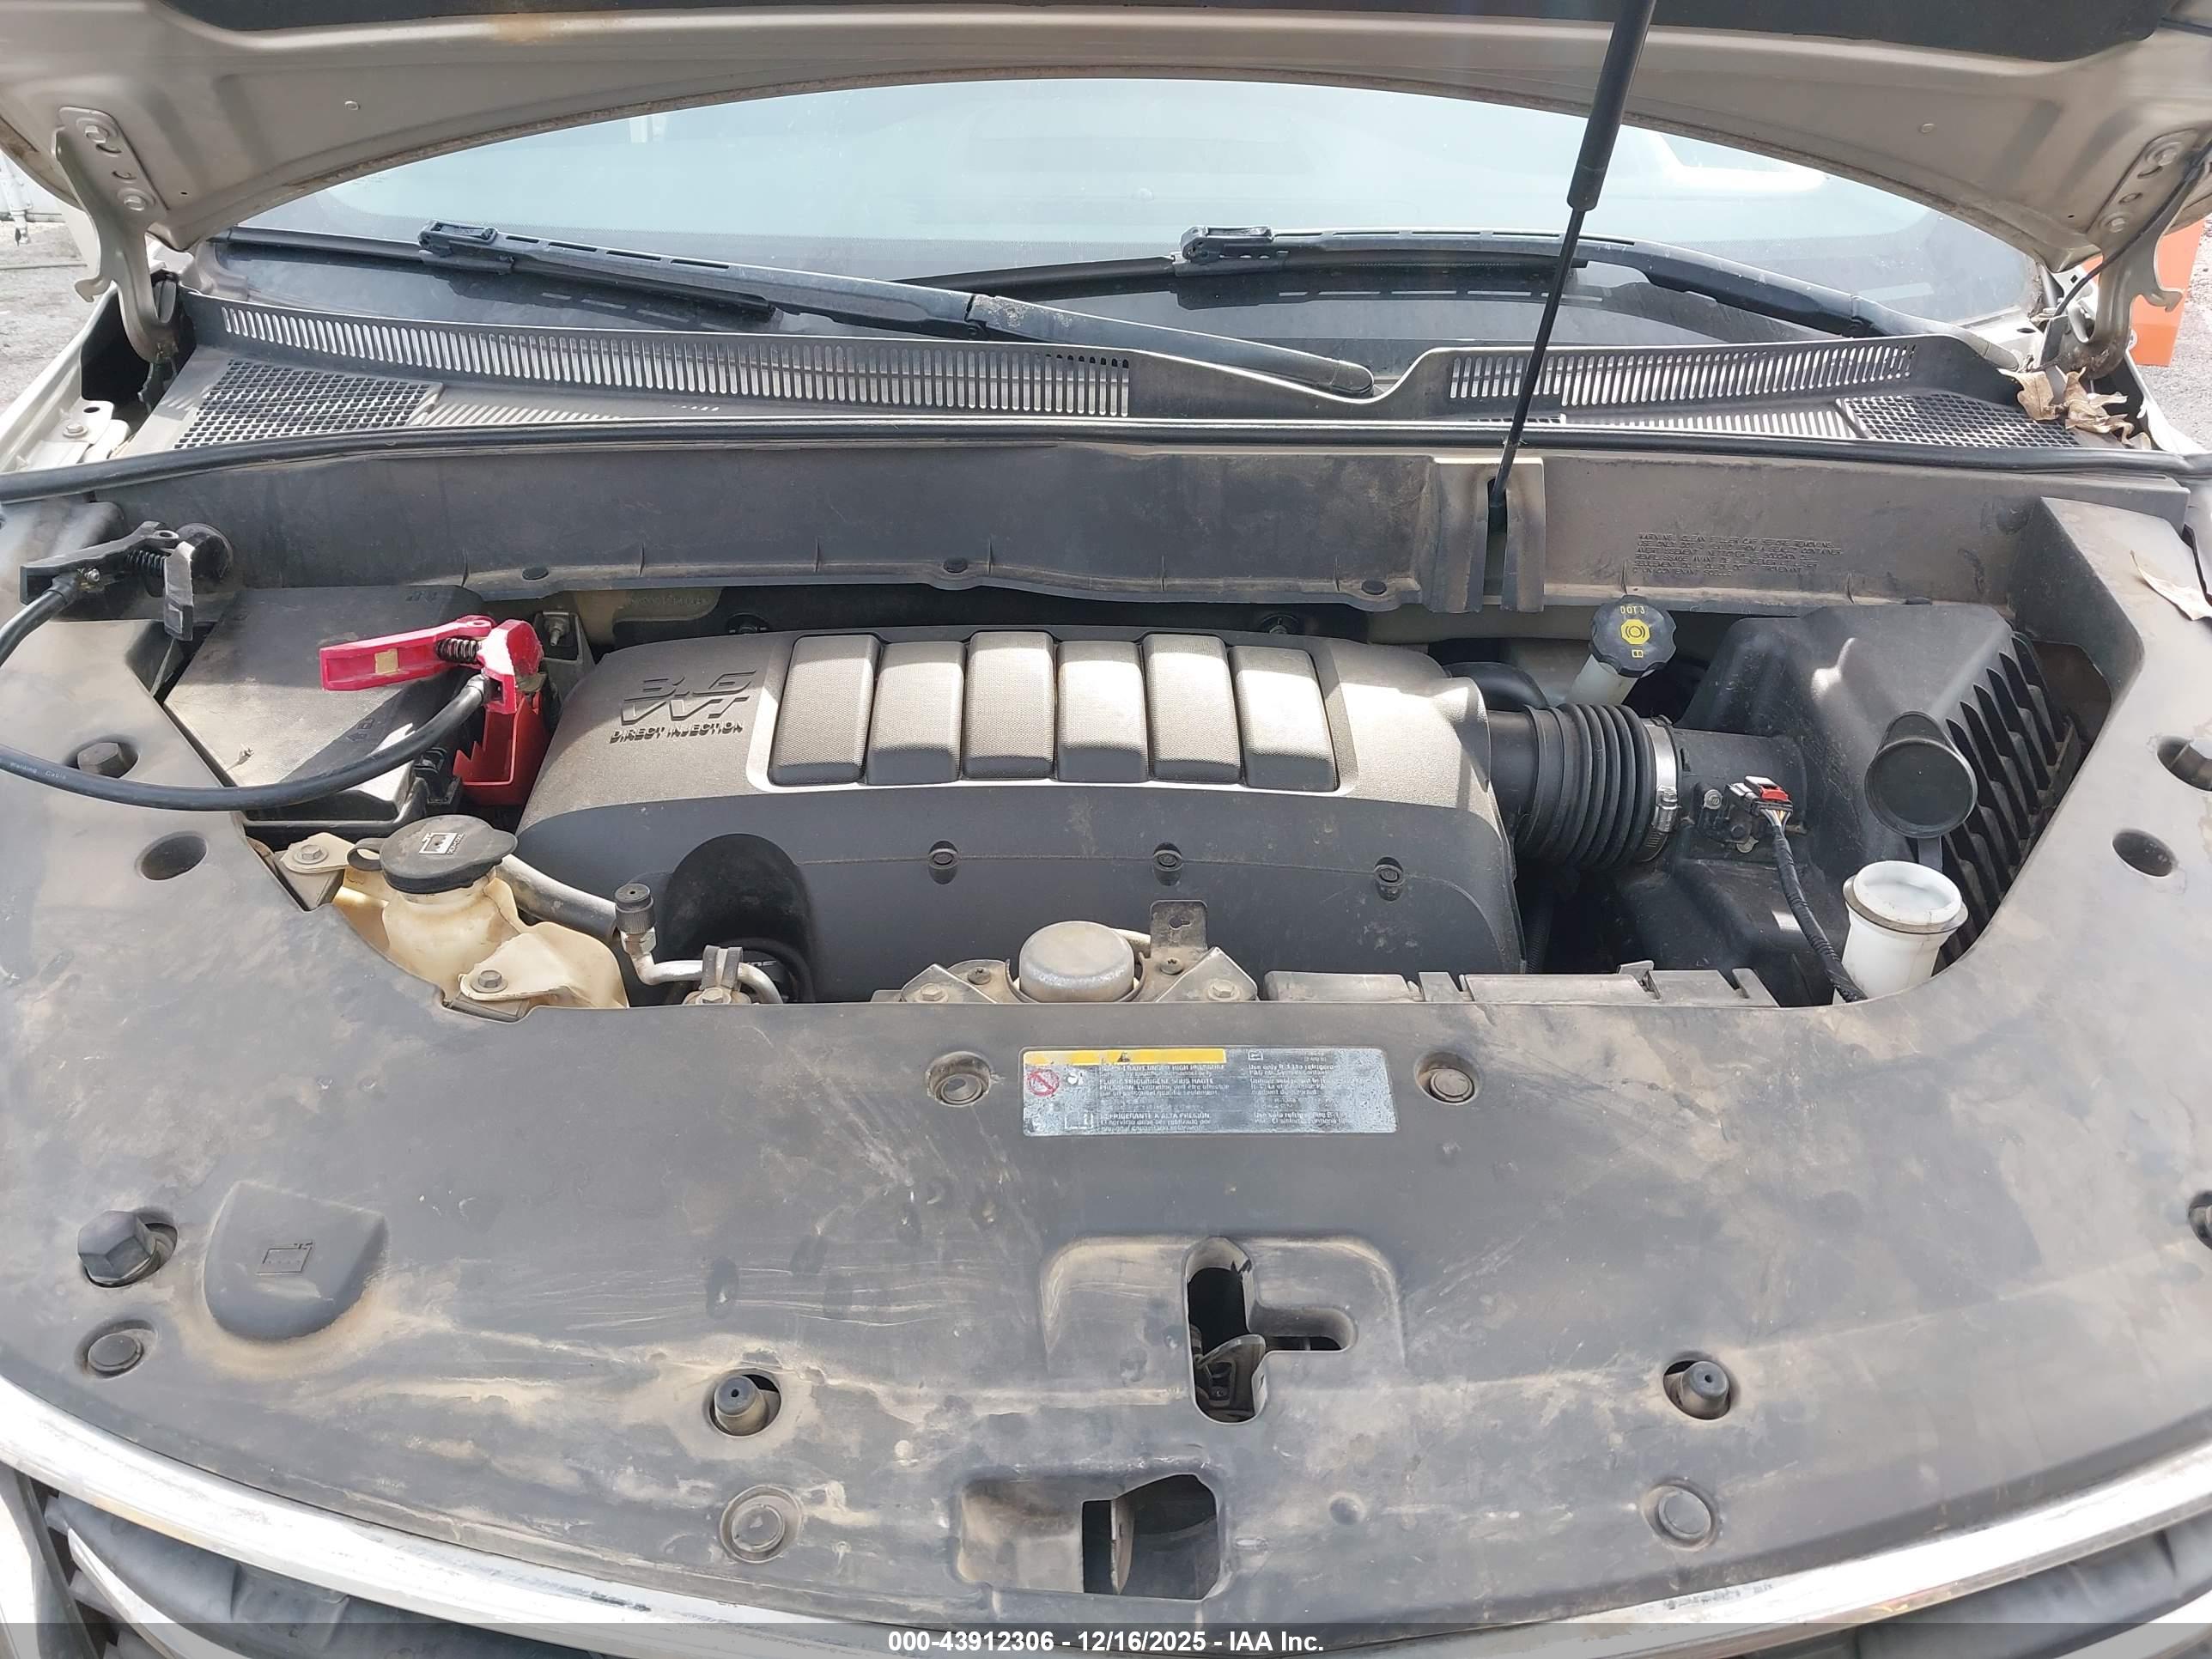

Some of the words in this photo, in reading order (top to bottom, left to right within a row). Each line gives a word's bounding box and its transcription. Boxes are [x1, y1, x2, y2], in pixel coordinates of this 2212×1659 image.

[1620, 605, 1637, 614] DOT
[1639, 605, 1645, 614] 3
[610, 726, 665, 744] DIRECT
[666, 720, 744, 738] INJECTION
